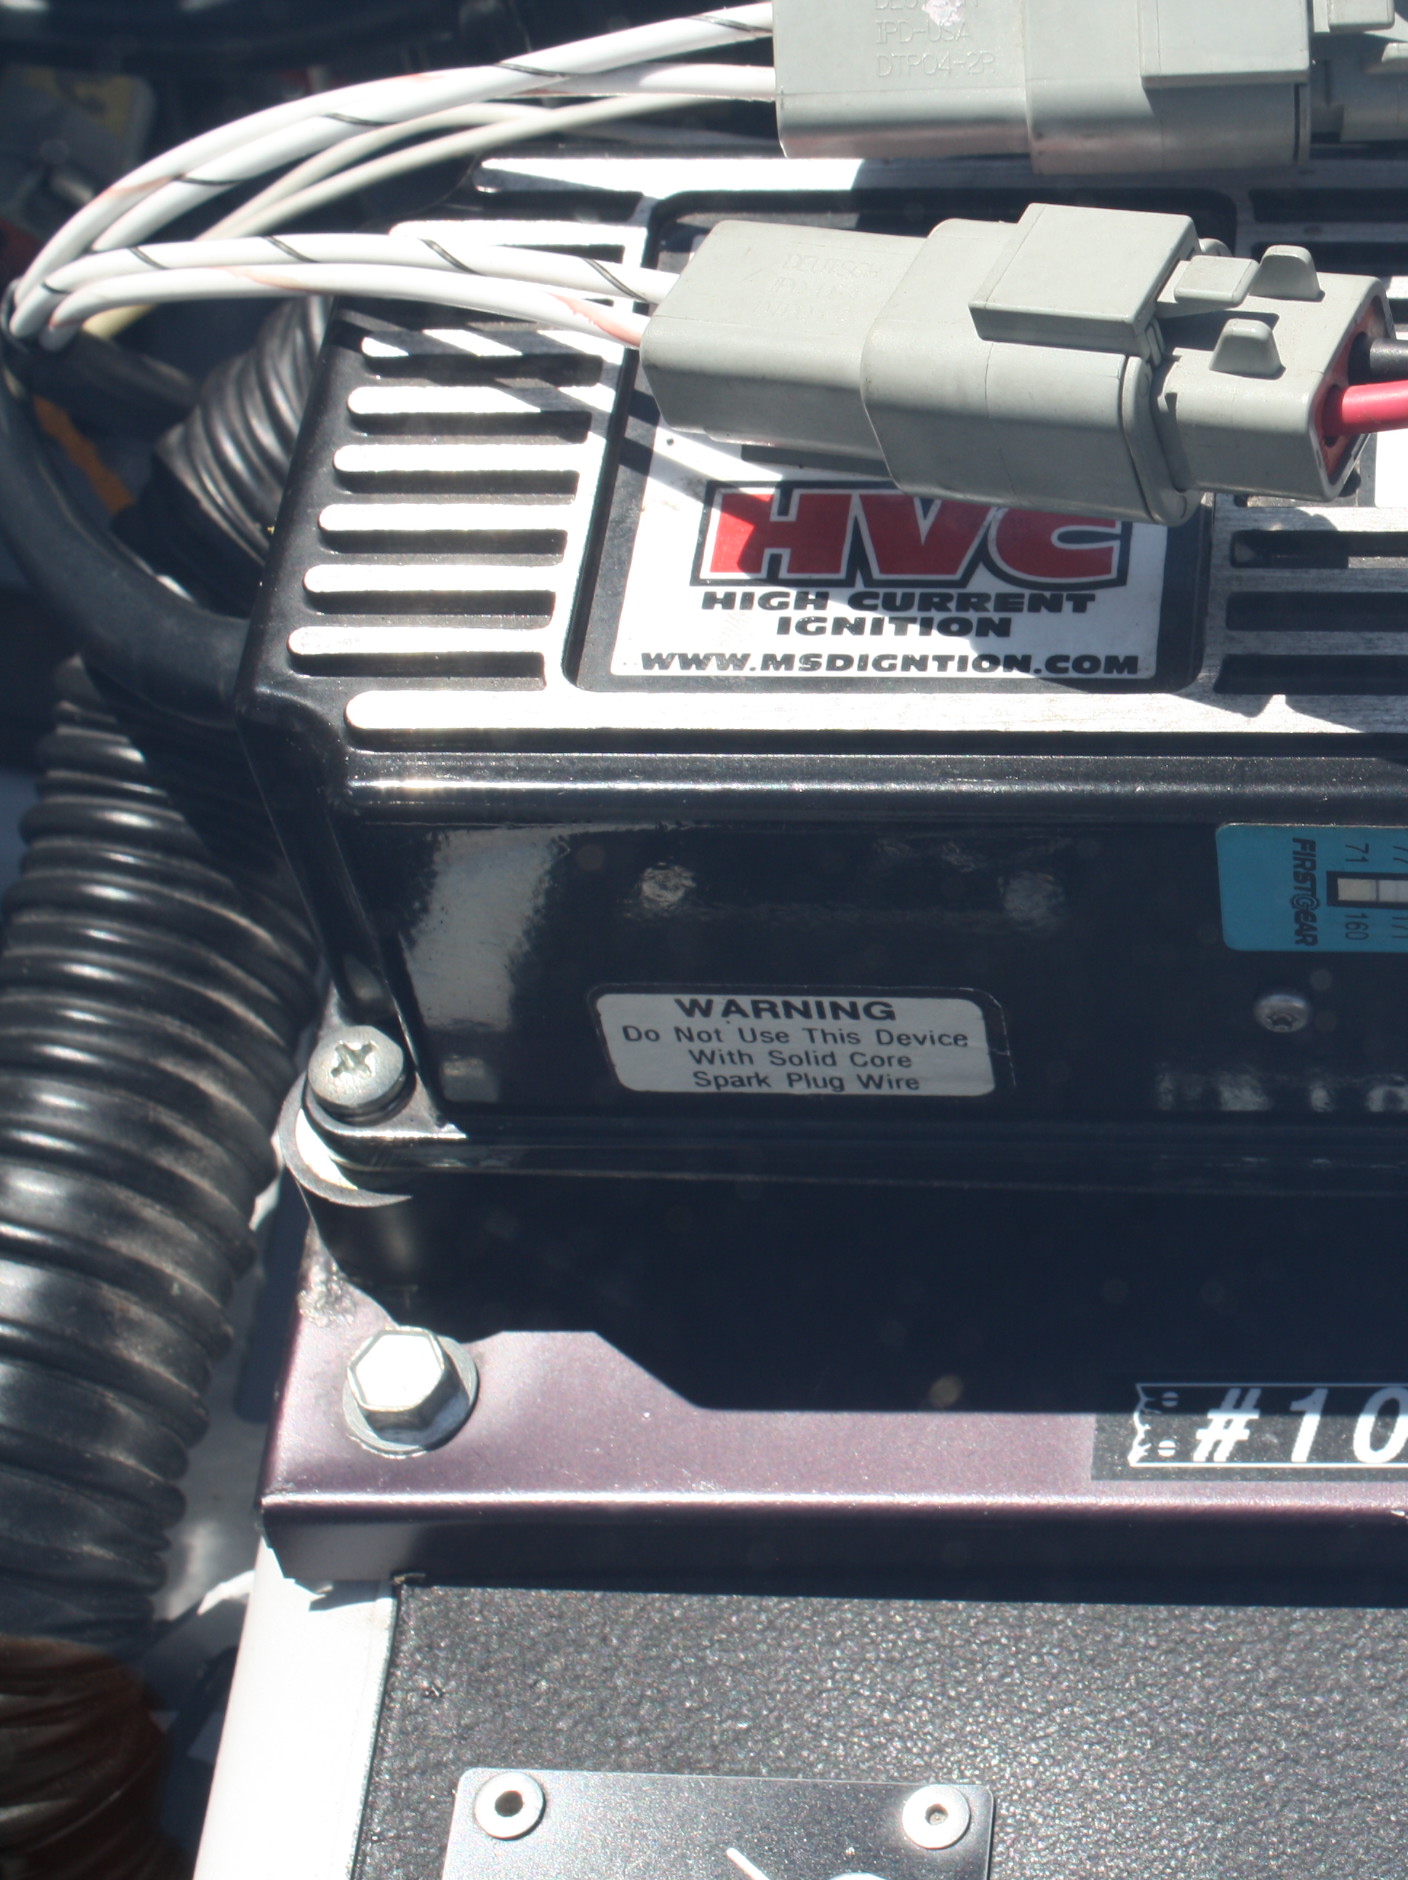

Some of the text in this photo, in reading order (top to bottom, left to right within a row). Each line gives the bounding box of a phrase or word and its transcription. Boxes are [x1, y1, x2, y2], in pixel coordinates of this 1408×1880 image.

[690, 480, 1133, 589] HVC
[701, 590, 1096, 613] HIGH CURRENT
[776, 616, 1013, 638] IGNITION
[640, 652, 1140, 676] WWW.MSDIGNTION.COM
[1345, 843, 1370, 862] 71
[1344, 913, 1369, 941] 160
[674, 998, 896, 1021] WARNING
[622, 1025, 969, 1047] Do Not Use This Device
[688, 1049, 913, 1069] With Solid Core
[693, 1071, 920, 1093] Spark Plug Wire
